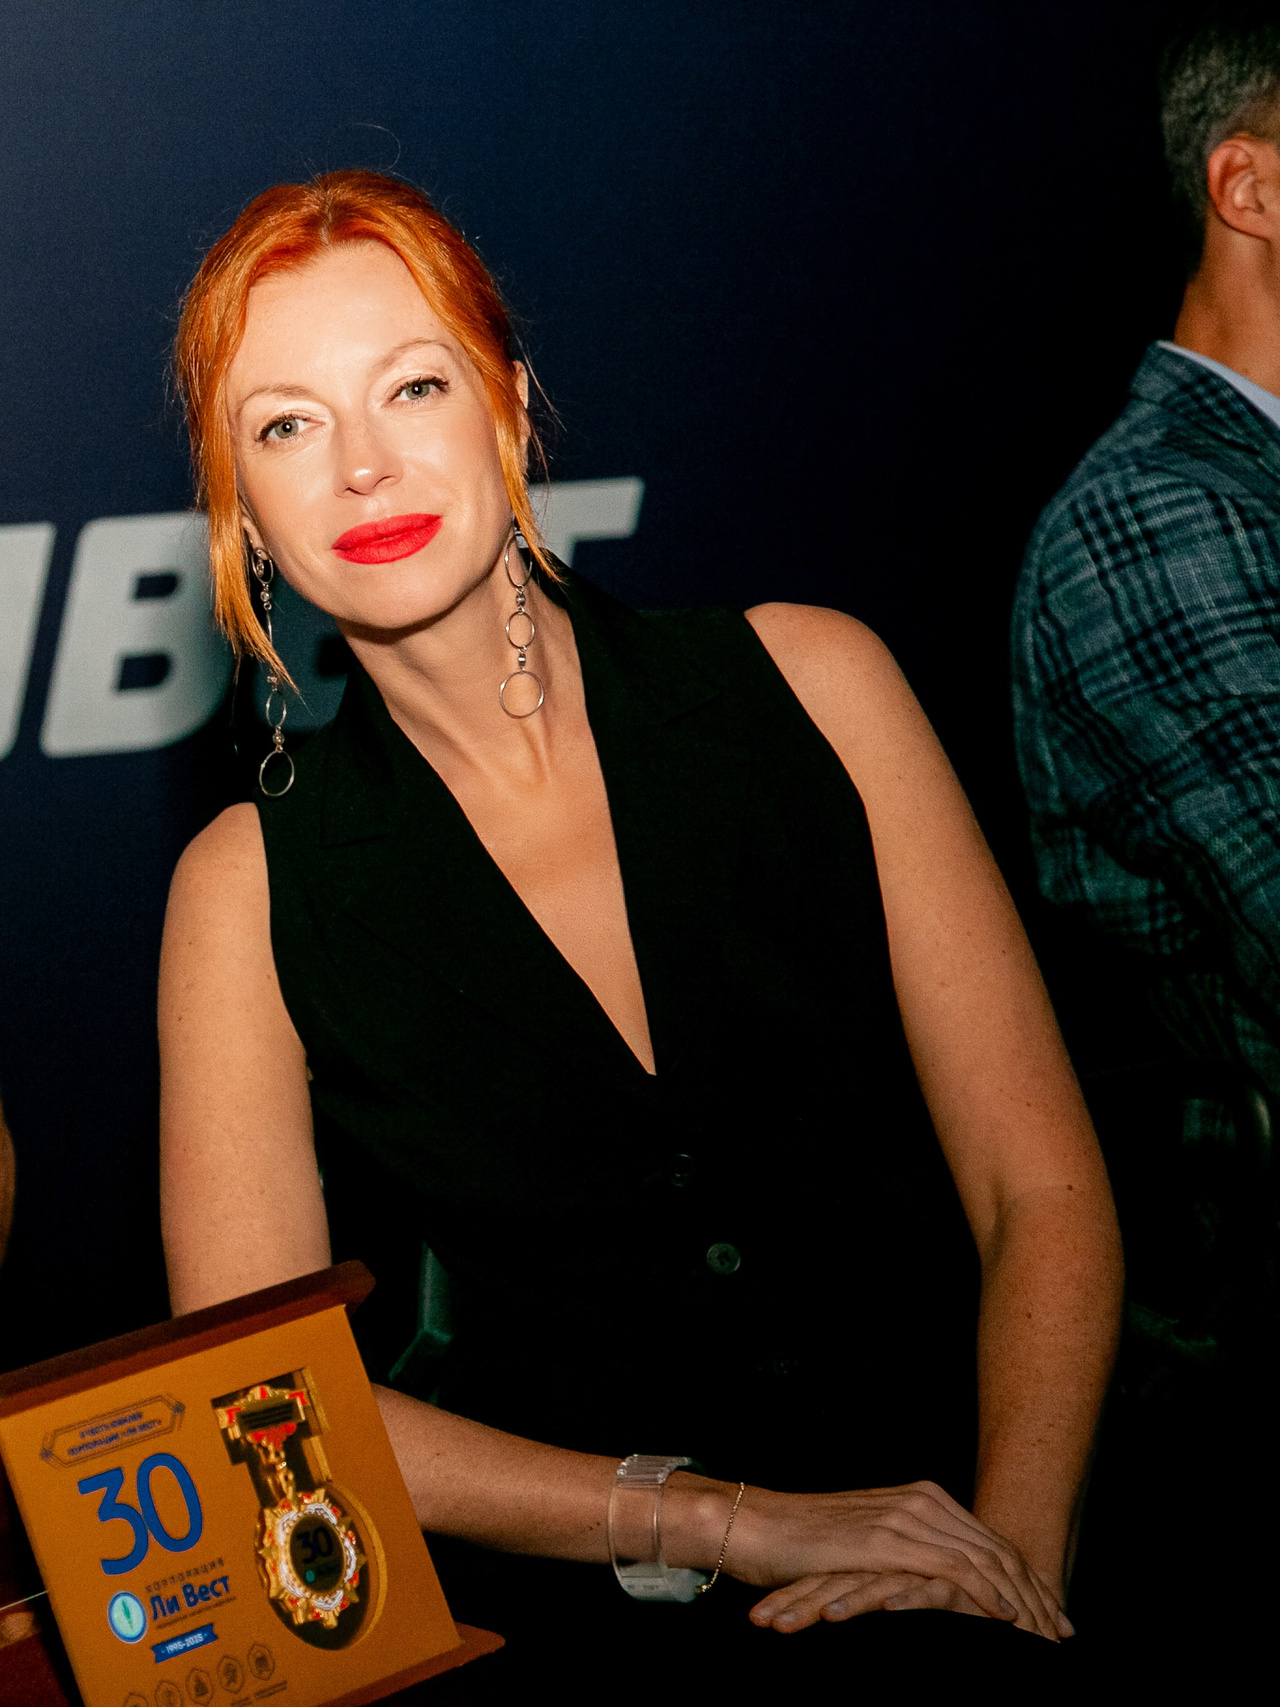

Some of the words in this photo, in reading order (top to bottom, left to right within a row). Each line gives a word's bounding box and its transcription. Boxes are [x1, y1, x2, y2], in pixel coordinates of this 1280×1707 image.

[77, 1452, 203, 1575] 30
[296, 1527, 333, 1564] 30
[150, 1595, 181, 1621] Ли
[181, 1575, 229, 1608] Вест
